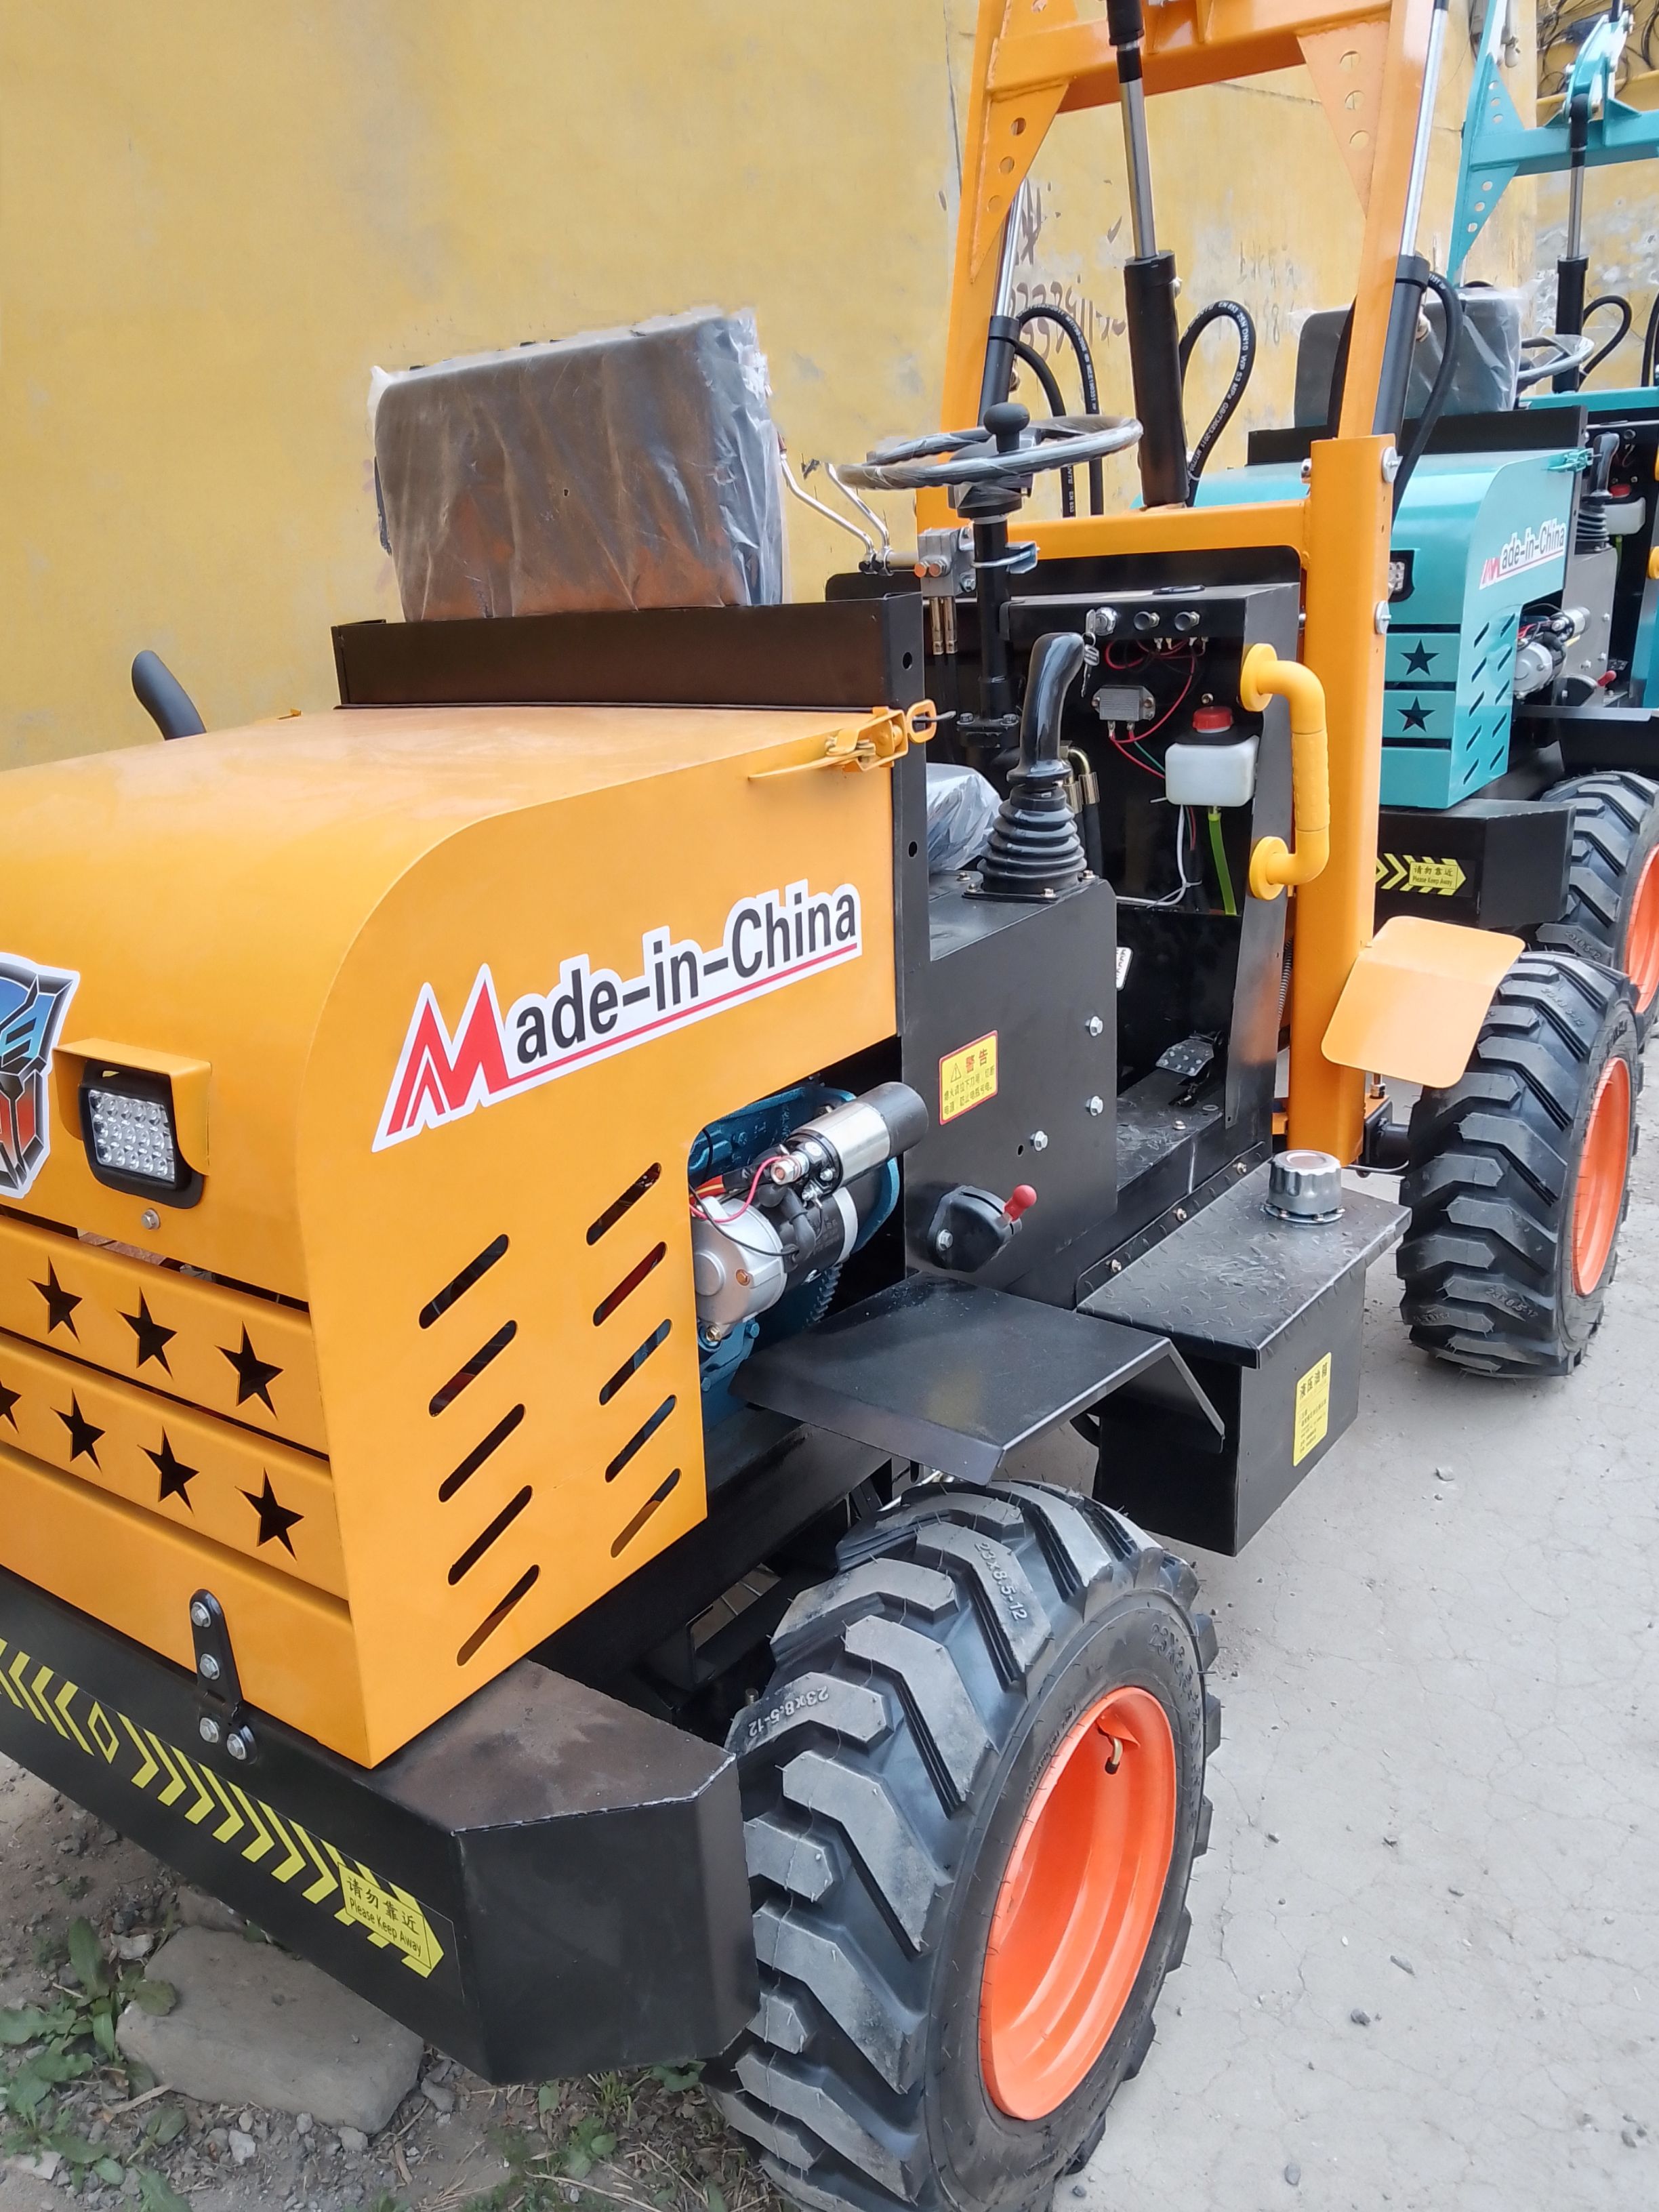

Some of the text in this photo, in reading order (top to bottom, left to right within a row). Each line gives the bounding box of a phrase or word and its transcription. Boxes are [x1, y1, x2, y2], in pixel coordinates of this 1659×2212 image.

[1240, 354, 1248, 370] WP
[1482, 523, 1564, 584] Made-in-China
[1414, 865, 1453, 877] 请勿靠近
[386, 891, 857, 1136] Made-in-China
[347, 1876, 420, 1936] 请勿靠近
[350, 1898, 422, 1957] Please Keep Away
